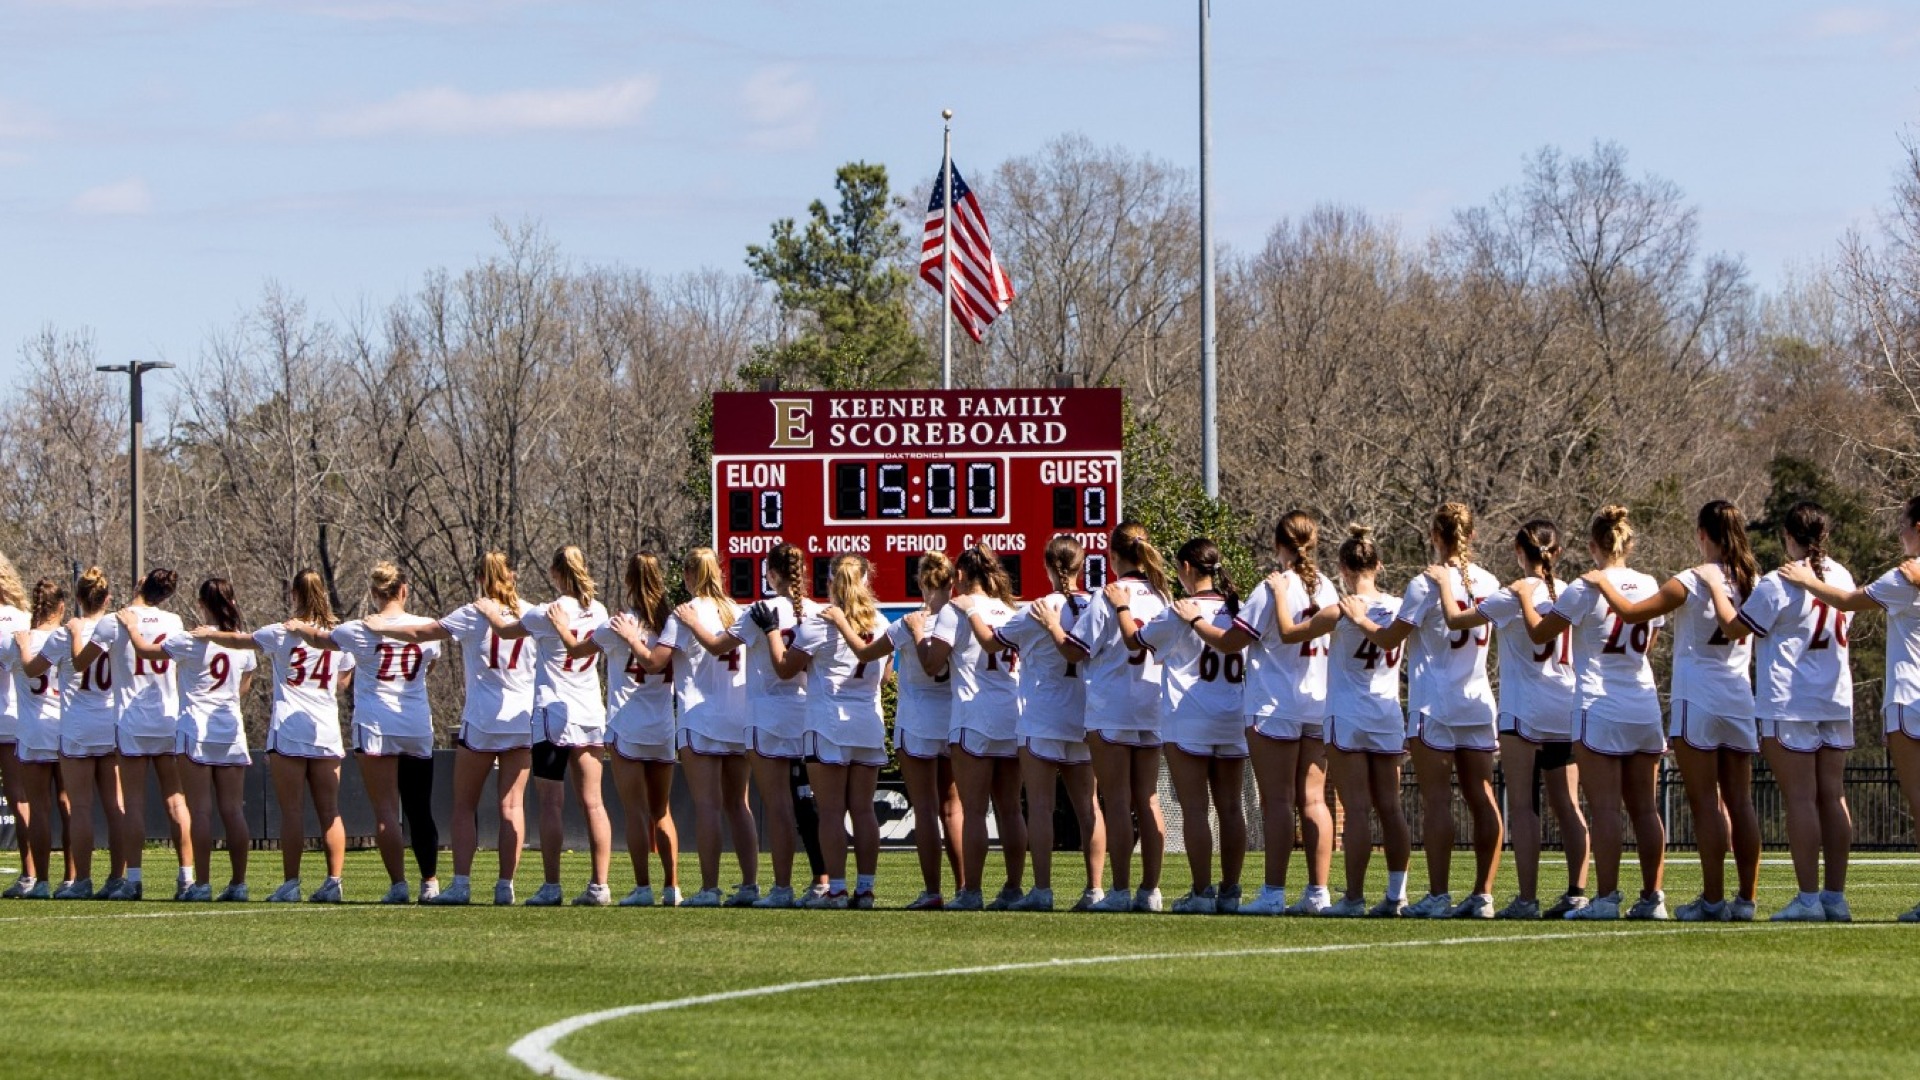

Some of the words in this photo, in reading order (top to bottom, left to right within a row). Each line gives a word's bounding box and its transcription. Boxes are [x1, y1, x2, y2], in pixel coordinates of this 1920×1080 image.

[829, 398, 948, 418] KEENER
[958, 396, 1066, 417] FAMILY
[769, 398, 814, 448] E
[829, 421, 1067, 446] SCOREBOARD
[726, 463, 786, 487] ELON
[1040, 459, 1117, 484] GUEST
[859, 463, 996, 514] 15:00
[761, 490, 782, 529] 0
[1084, 487, 1105, 525] 0
[808, 535, 822, 553] C.
[826, 534, 871, 553] KICKS
[886, 533, 947, 552] PERIOD
[981, 533, 1026, 551] KICKS
[1052, 532, 1108, 550] OTS
[1299, 605, 1329, 657] 2
[209, 651, 231, 692] 9
[286, 646, 333, 690] 34
[374, 643, 423, 682] 20
